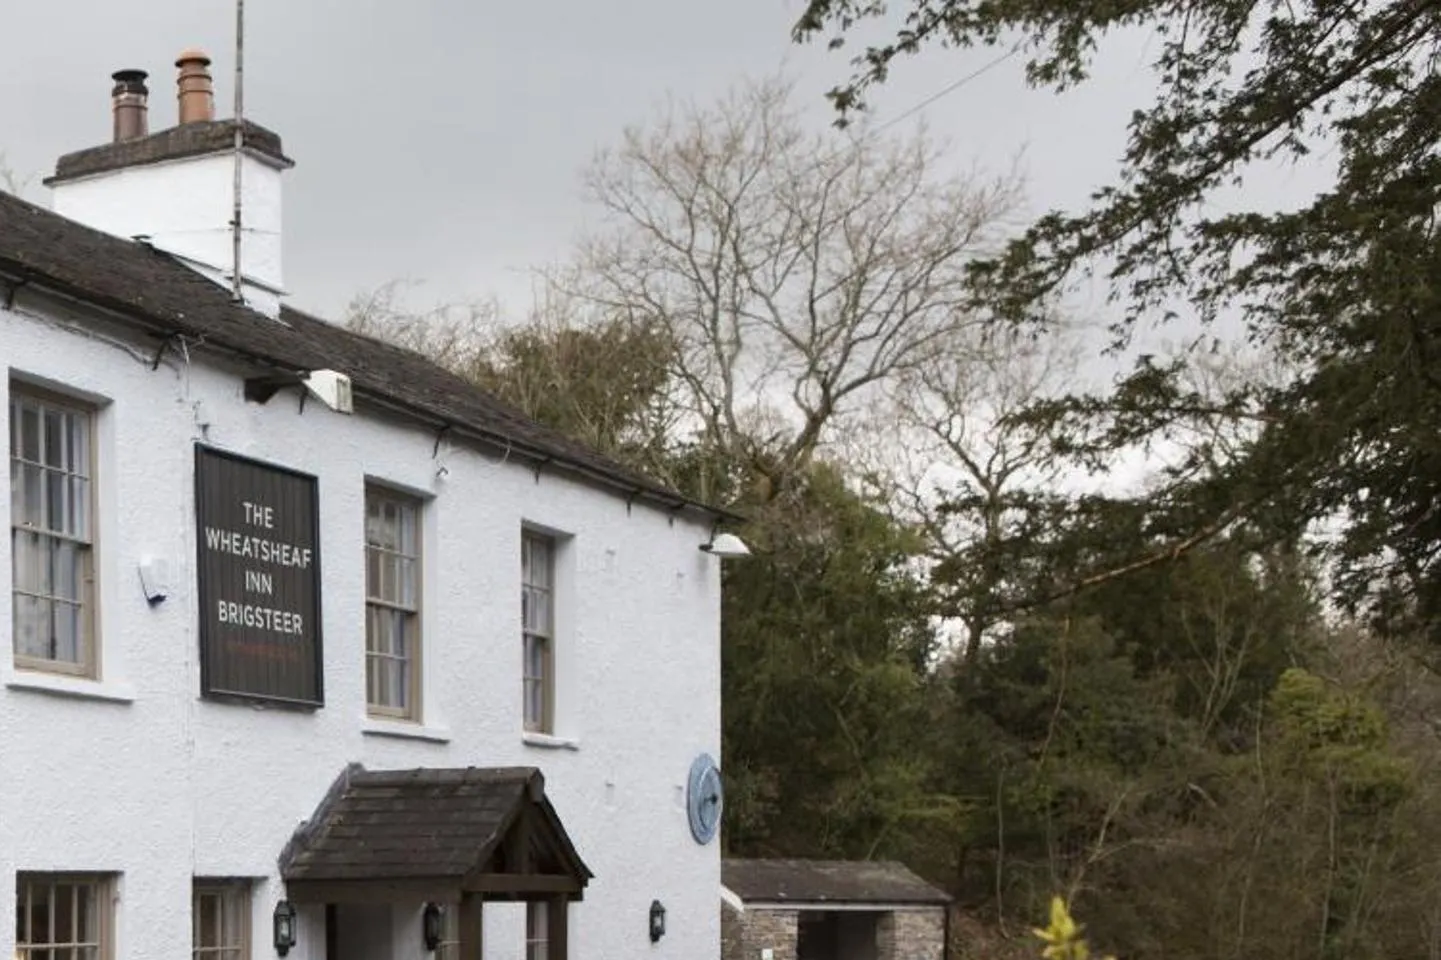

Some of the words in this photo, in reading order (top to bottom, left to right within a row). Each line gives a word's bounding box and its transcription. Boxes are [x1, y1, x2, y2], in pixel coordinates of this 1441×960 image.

[242, 501, 273, 529] THE
[205, 526, 312, 569] WHEATSHEAF
[245, 569, 273, 595] INN
[218, 600, 303, 635] BRIGSTEER
